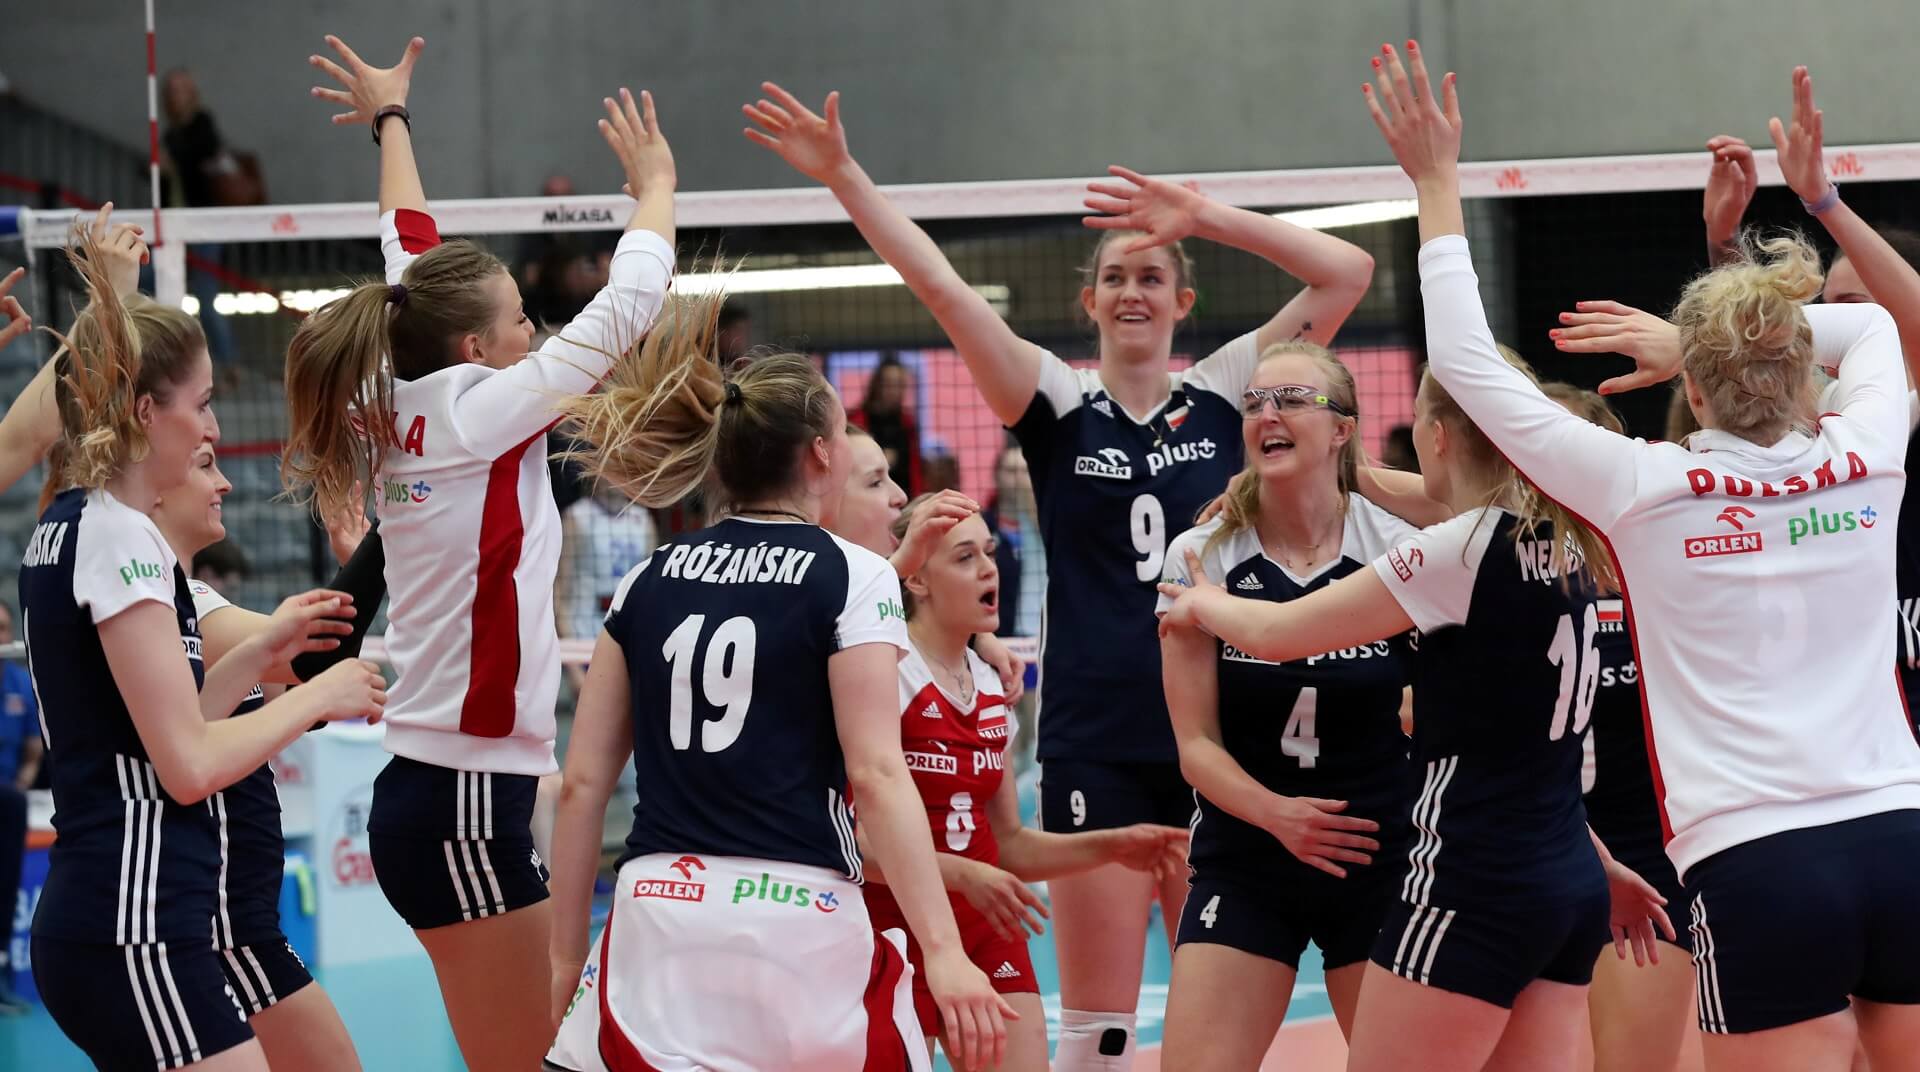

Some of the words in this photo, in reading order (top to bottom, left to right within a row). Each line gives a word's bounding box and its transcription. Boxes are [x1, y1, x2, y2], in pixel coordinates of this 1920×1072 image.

[1148, 443, 1199, 476] plus
[1130, 494, 1166, 582] 9
[1789, 507, 1857, 545] plus
[1689, 535, 1758, 555] ORLEN
[120, 559, 160, 586] plus
[661, 541, 816, 585] RÓŻAŃSKI
[1237, 581, 1264, 591] adidas
[662, 614, 756, 753] 19
[1547, 603, 1600, 741] 16
[1281, 687, 1319, 768] 4
[907, 755, 954, 771] ORLEN
[946, 792, 976, 851] 8
[1070, 790, 1086, 826] 9
[637, 882, 700, 898] ORLEN
[732, 873, 811, 907] plus
[1200, 896, 1220, 929] 4
